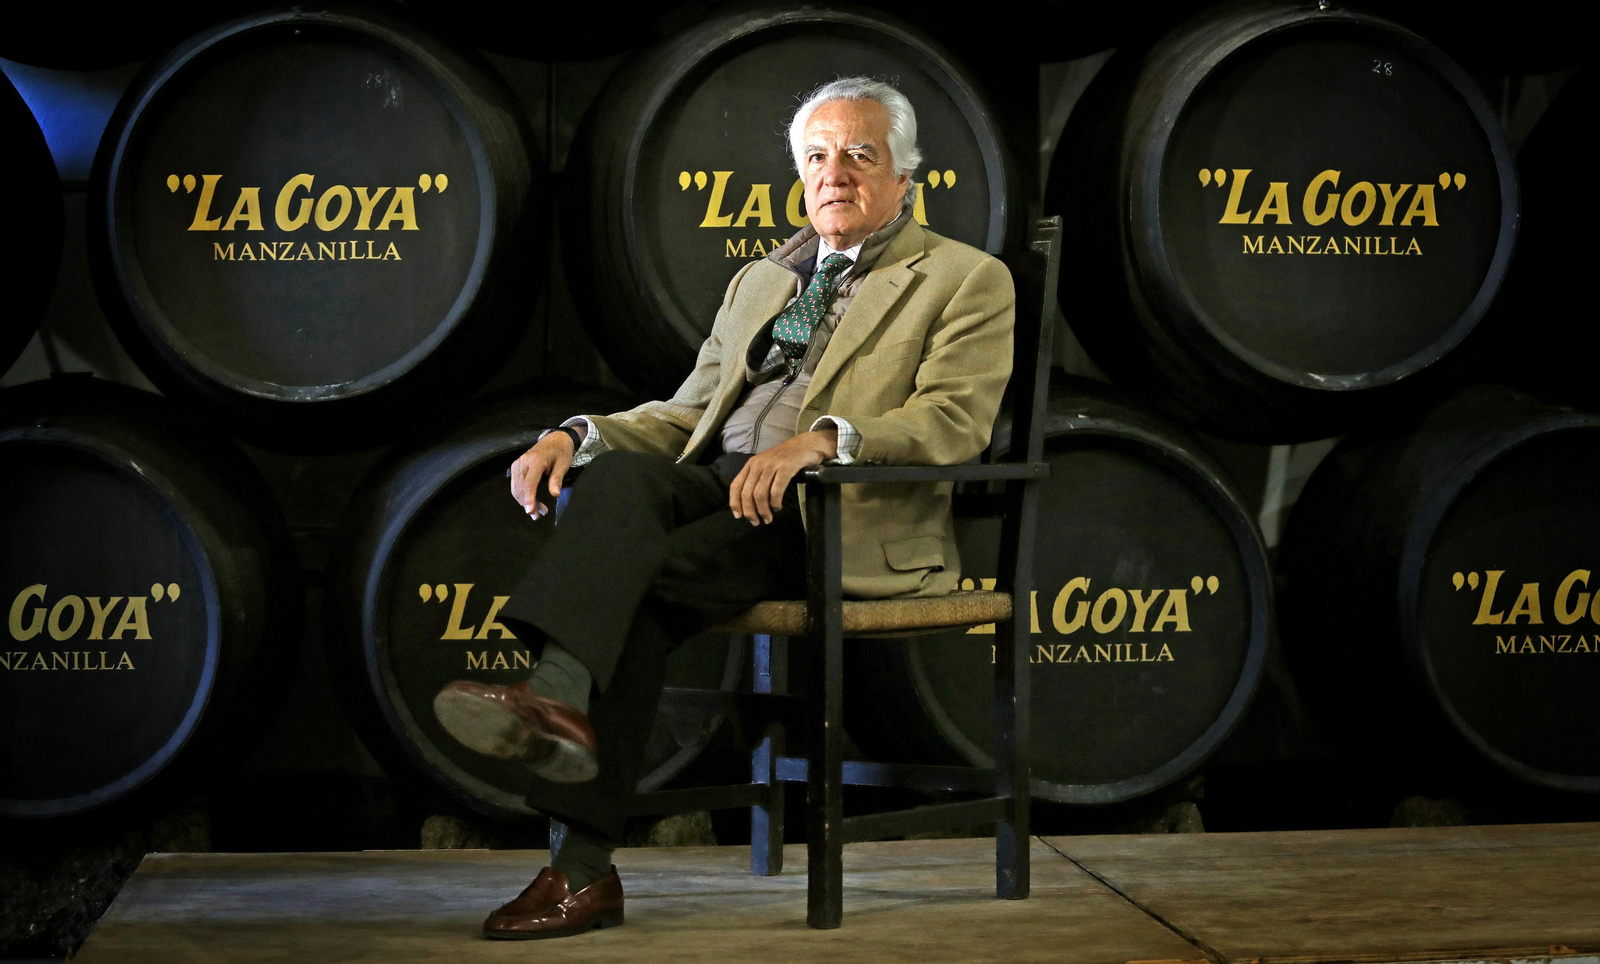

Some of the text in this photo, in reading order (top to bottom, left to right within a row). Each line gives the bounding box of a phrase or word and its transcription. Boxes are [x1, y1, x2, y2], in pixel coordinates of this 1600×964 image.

[1372, 59, 1393, 76] 28
[213, 241, 402, 262] MANZANILLA
[1242, 235, 1423, 256] MANZANILLA
[991, 642, 1177, 664] NZANILLA
